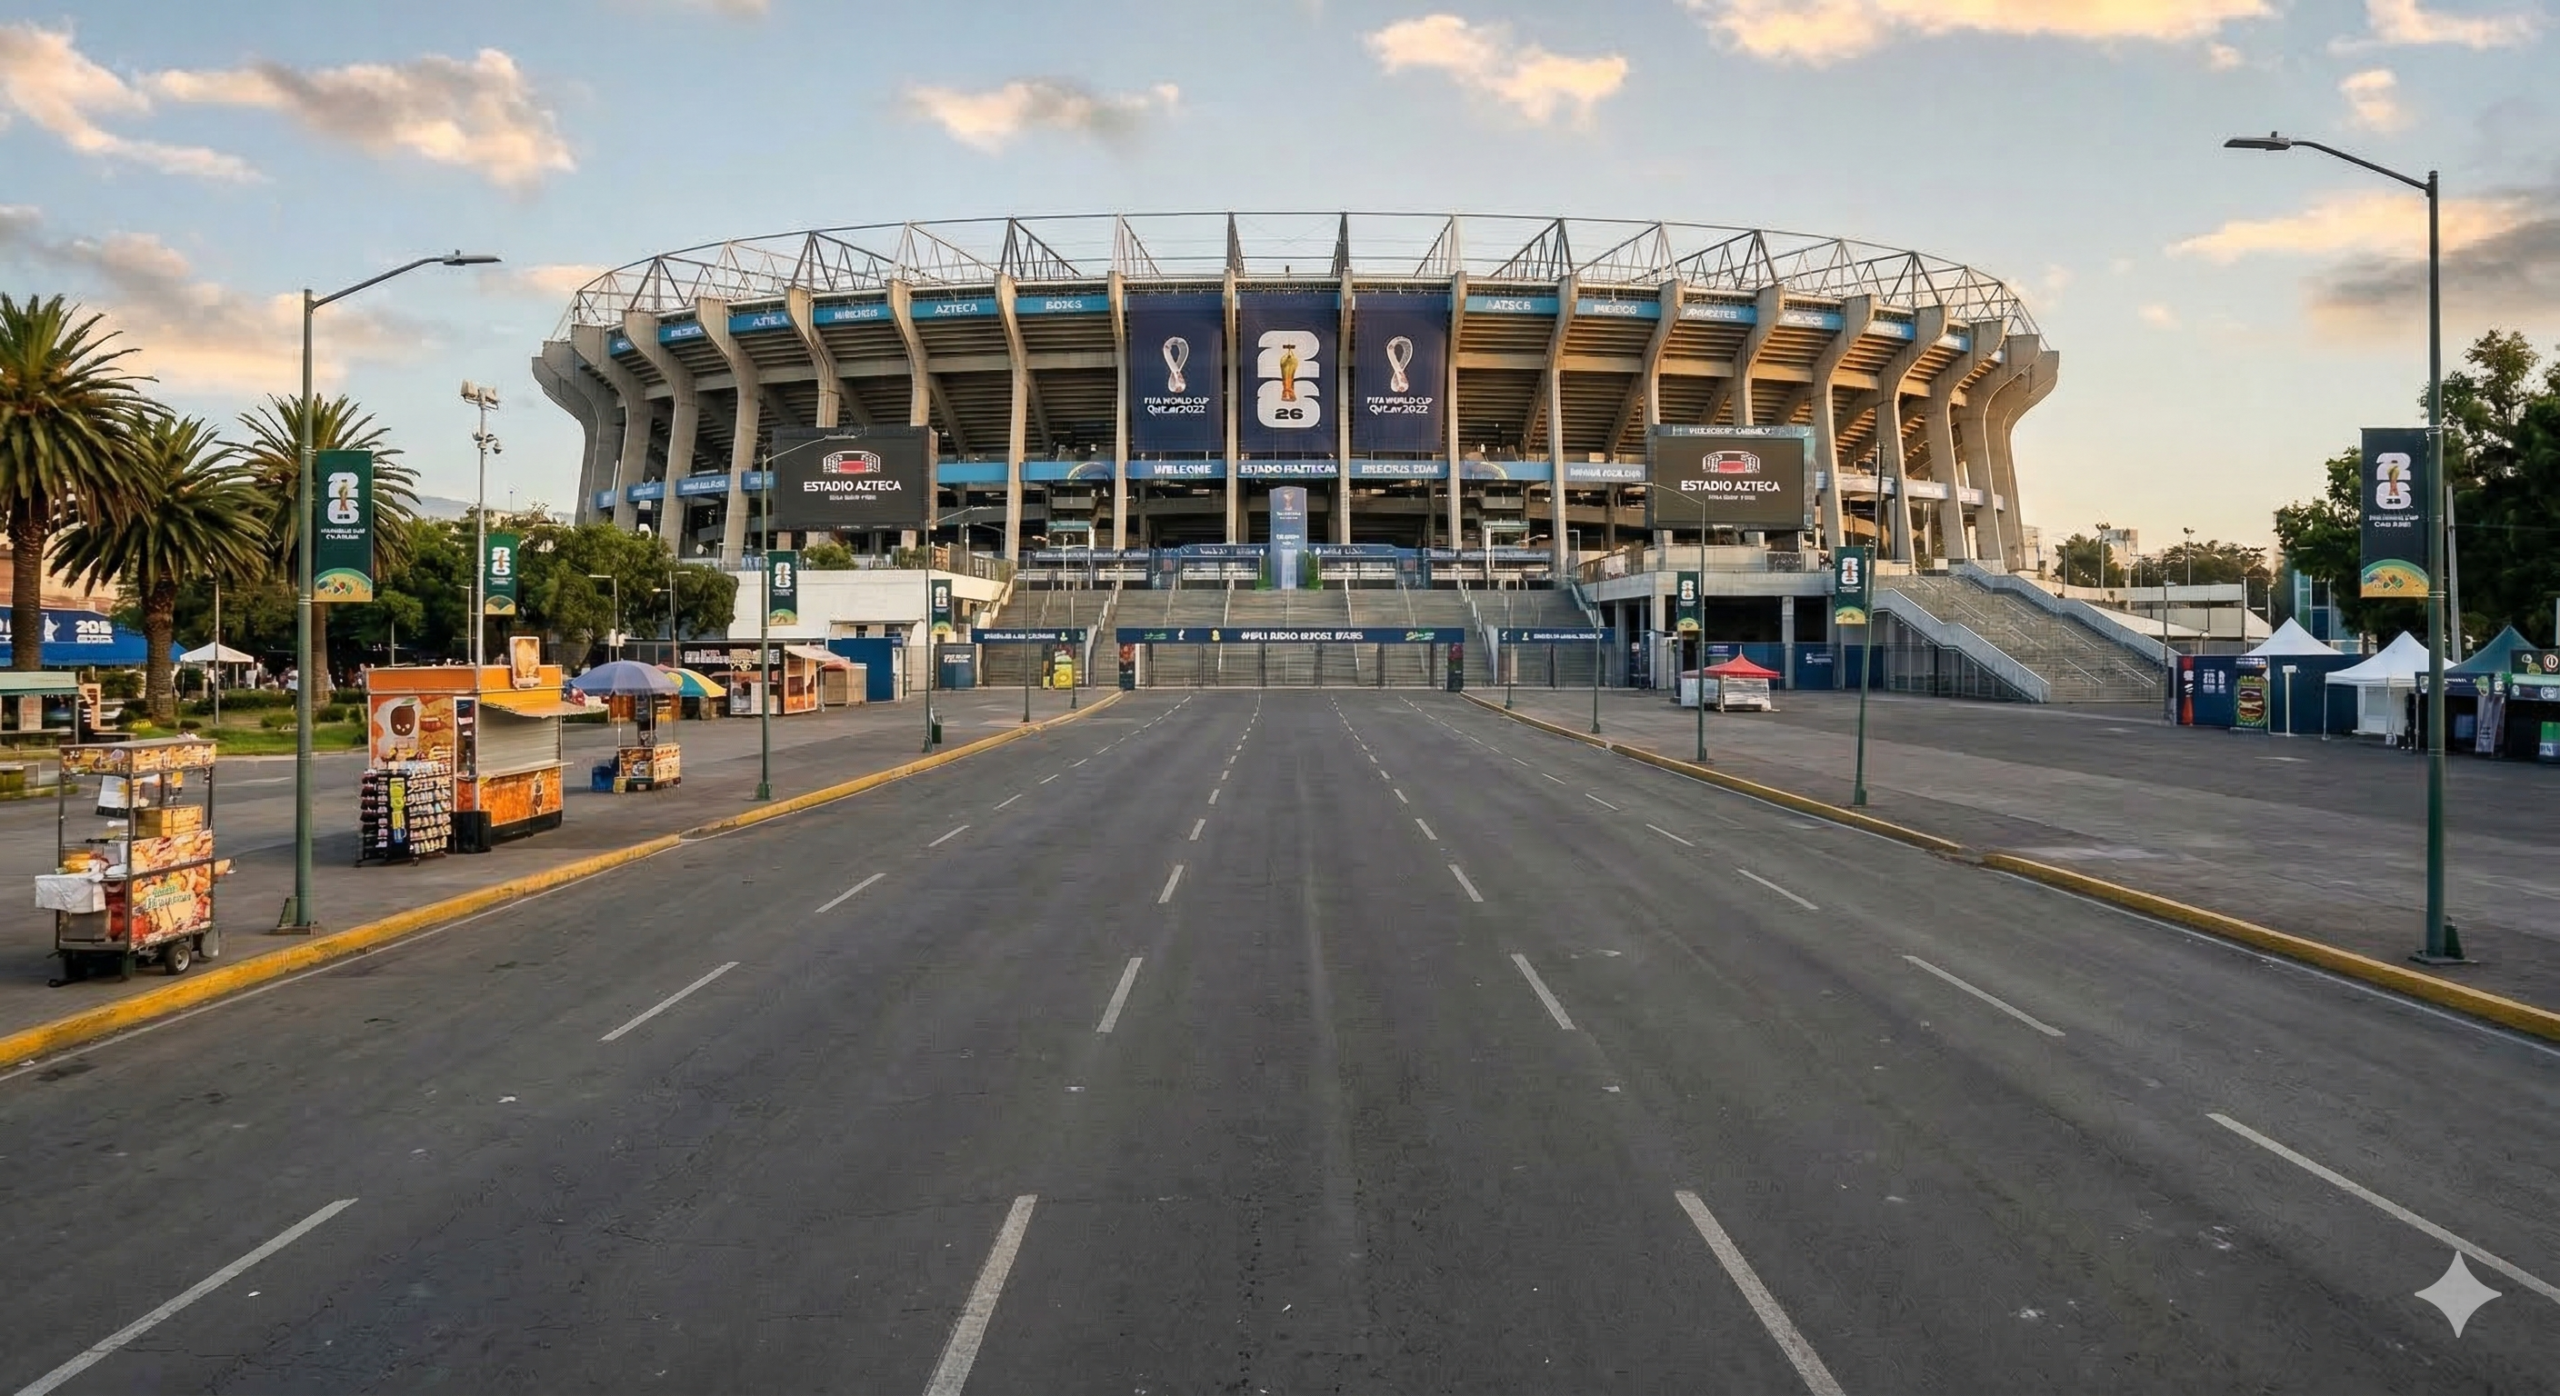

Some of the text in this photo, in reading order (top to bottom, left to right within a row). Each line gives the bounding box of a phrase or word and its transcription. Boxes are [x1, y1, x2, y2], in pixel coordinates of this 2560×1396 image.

[934, 303, 978, 314] AZTECA
[1193, 396, 1210, 405] CUP
[1274, 408, 1304, 420] 26
[803, 479, 902, 492] ESTADIO AZTECA
[1680, 480, 1781, 492] ESTADIO AZTECA
